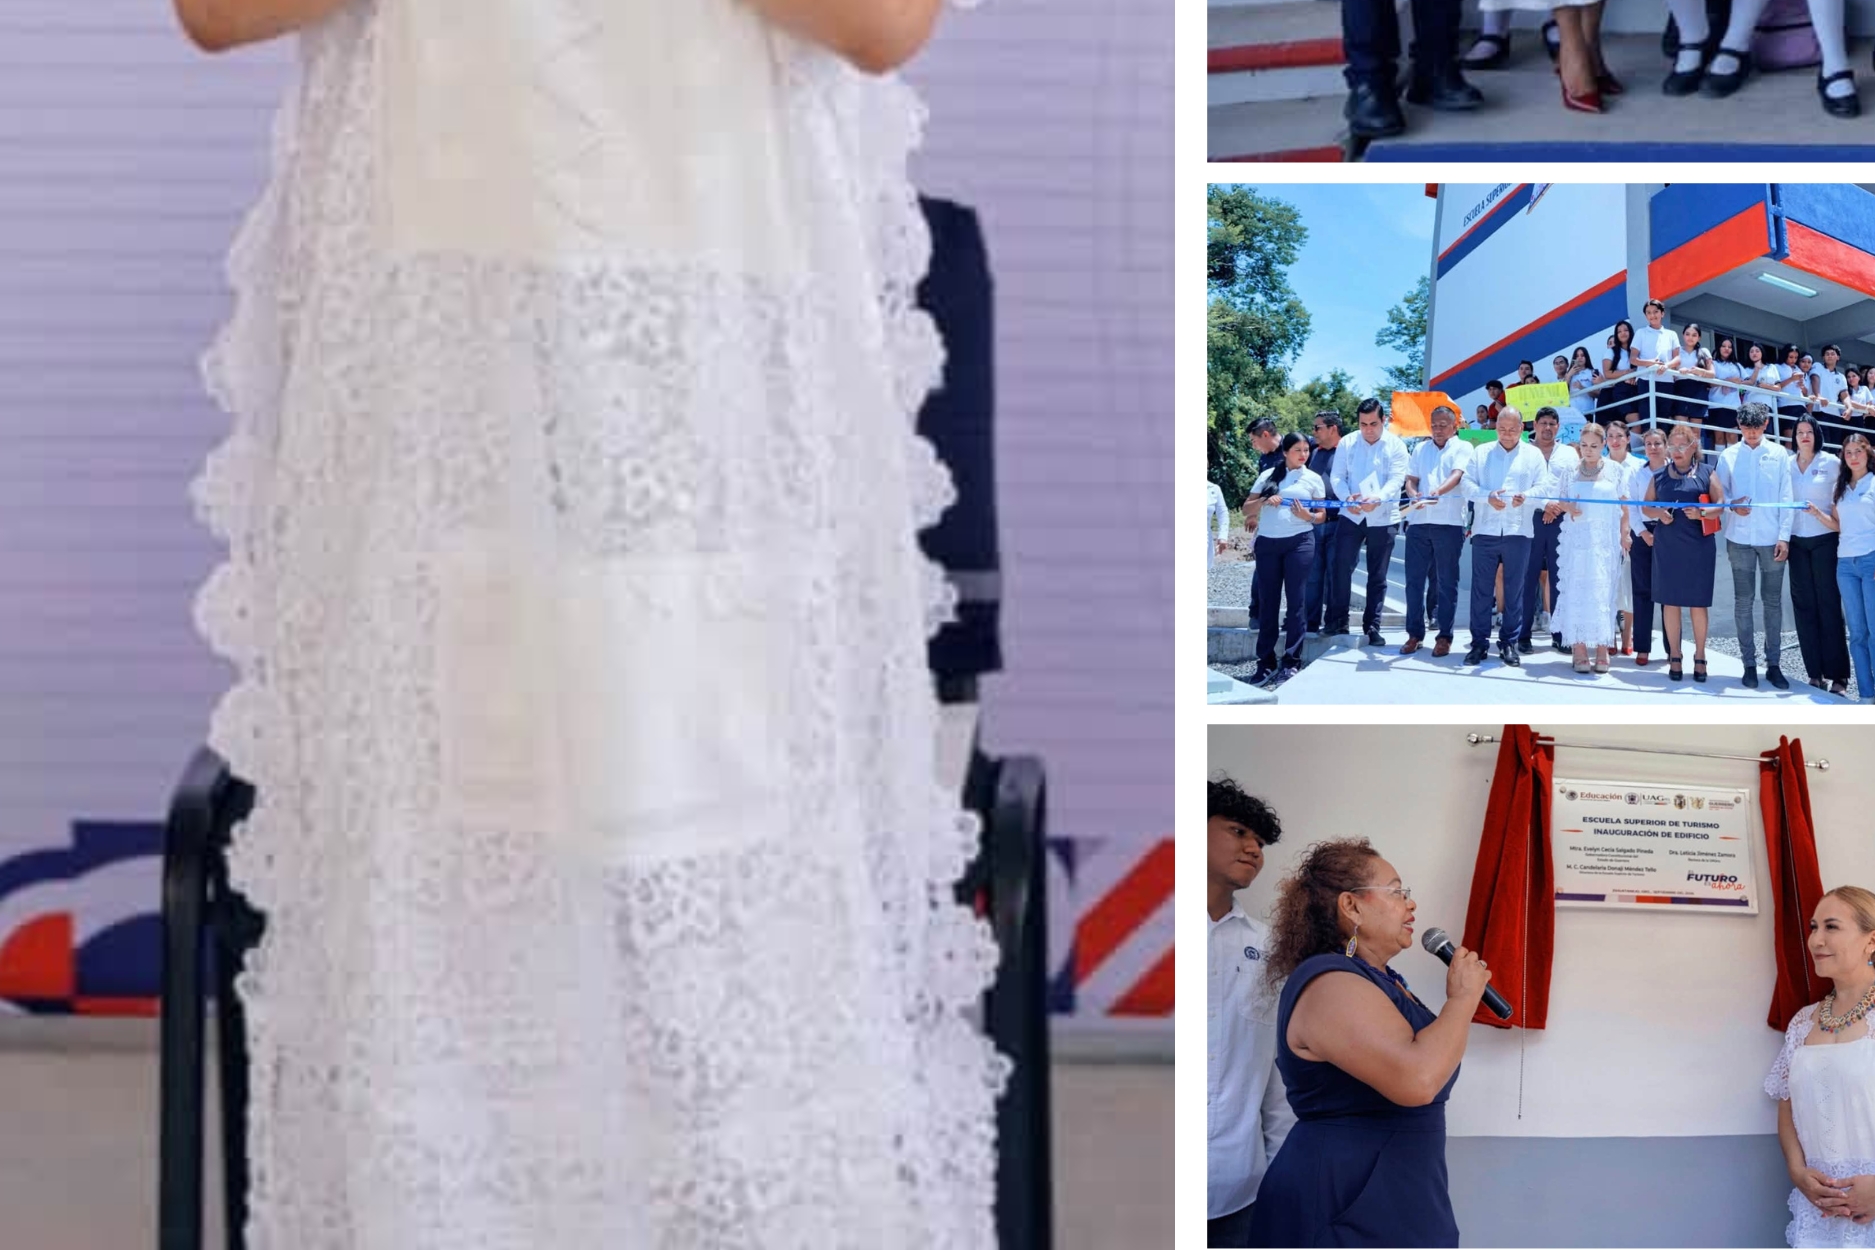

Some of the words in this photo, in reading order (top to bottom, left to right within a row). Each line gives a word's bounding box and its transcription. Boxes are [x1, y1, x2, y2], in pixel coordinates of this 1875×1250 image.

[1580, 791, 1622, 800] Educación
[1582, 816, 1621, 824] ESCUELA
[1624, 818, 1667, 826] SUPERIOR
[1682, 821, 1720, 829] TURISMO
[1593, 828, 1659, 838] INAUGURACIÓN
[1674, 832, 1710, 840] EDIFICIO
[1687, 873, 1738, 883] FUTURO
[1711, 876, 1745, 890] ahora
